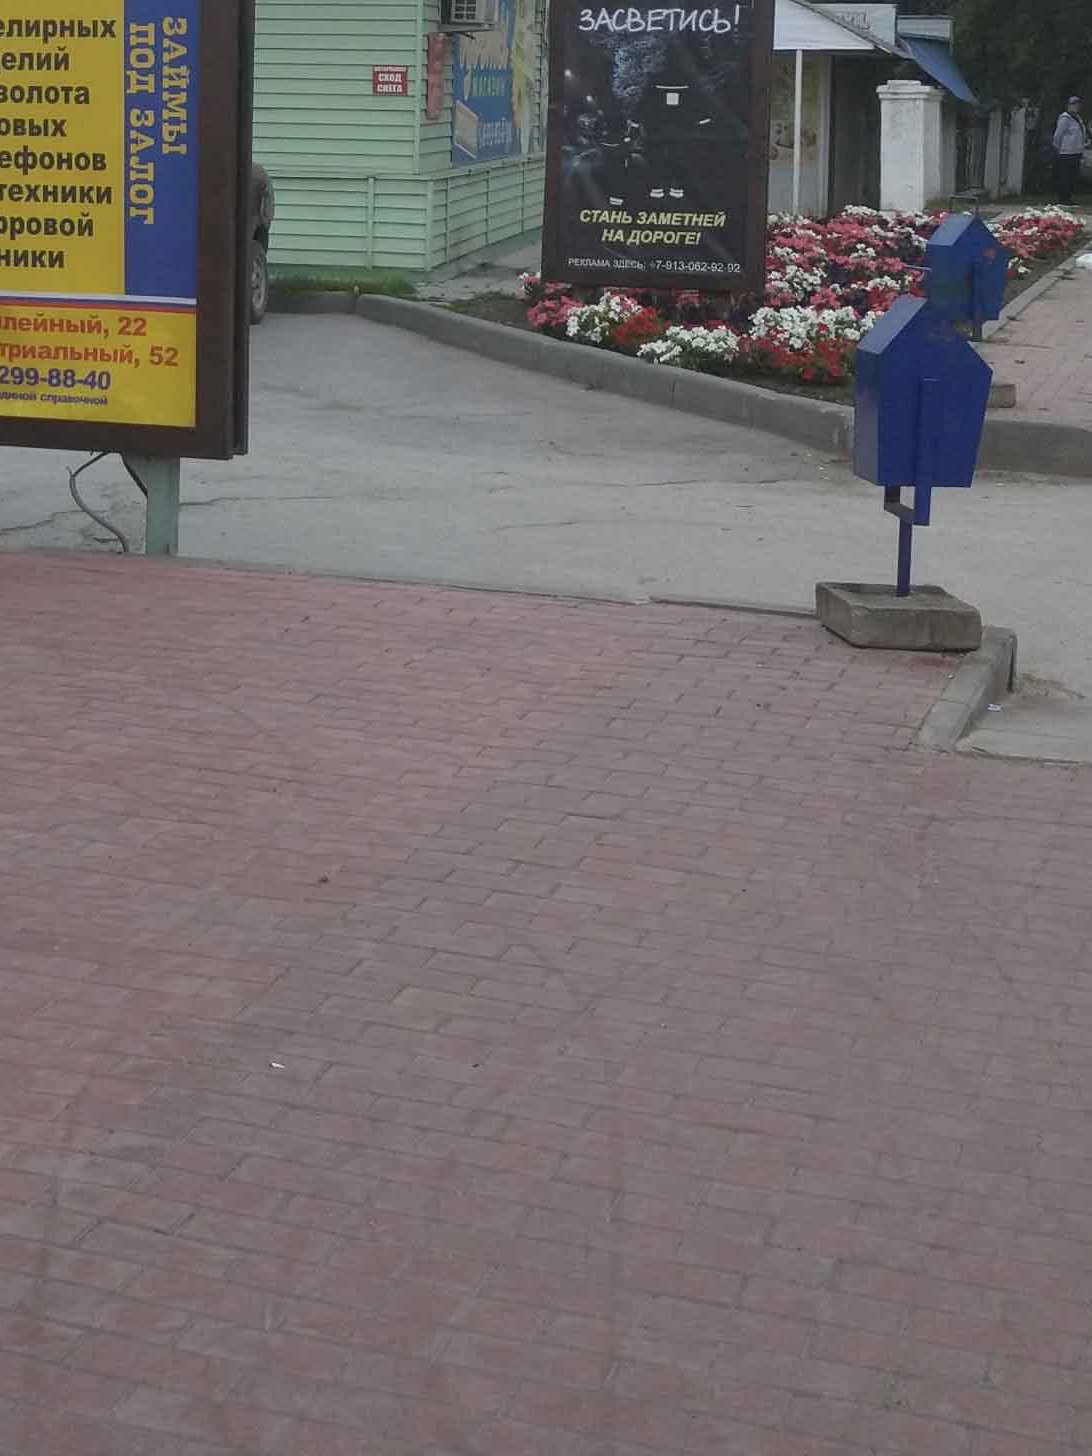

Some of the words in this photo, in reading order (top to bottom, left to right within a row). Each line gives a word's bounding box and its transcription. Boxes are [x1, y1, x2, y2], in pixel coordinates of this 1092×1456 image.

[578, 4, 740, 33] ЗАСВЕТИСЬ!
[126, 22, 156, 94] ПОД
[162, 16, 189, 156] ЗАЙМЫ
[128, 108, 156, 225] ЗАЛОГ
[579, 210, 633, 224] СТАНЬ
[636, 211, 726, 228] ЗАМЕТНЕЙ
[601, 229, 624, 242] НА
[627, 230, 701, 245] ДОРОГЕ!
[568, 258, 611, 268] РЕКЛАМА
[117, 316, 147, 336] 22
[149, 345, 179, 367] 52
